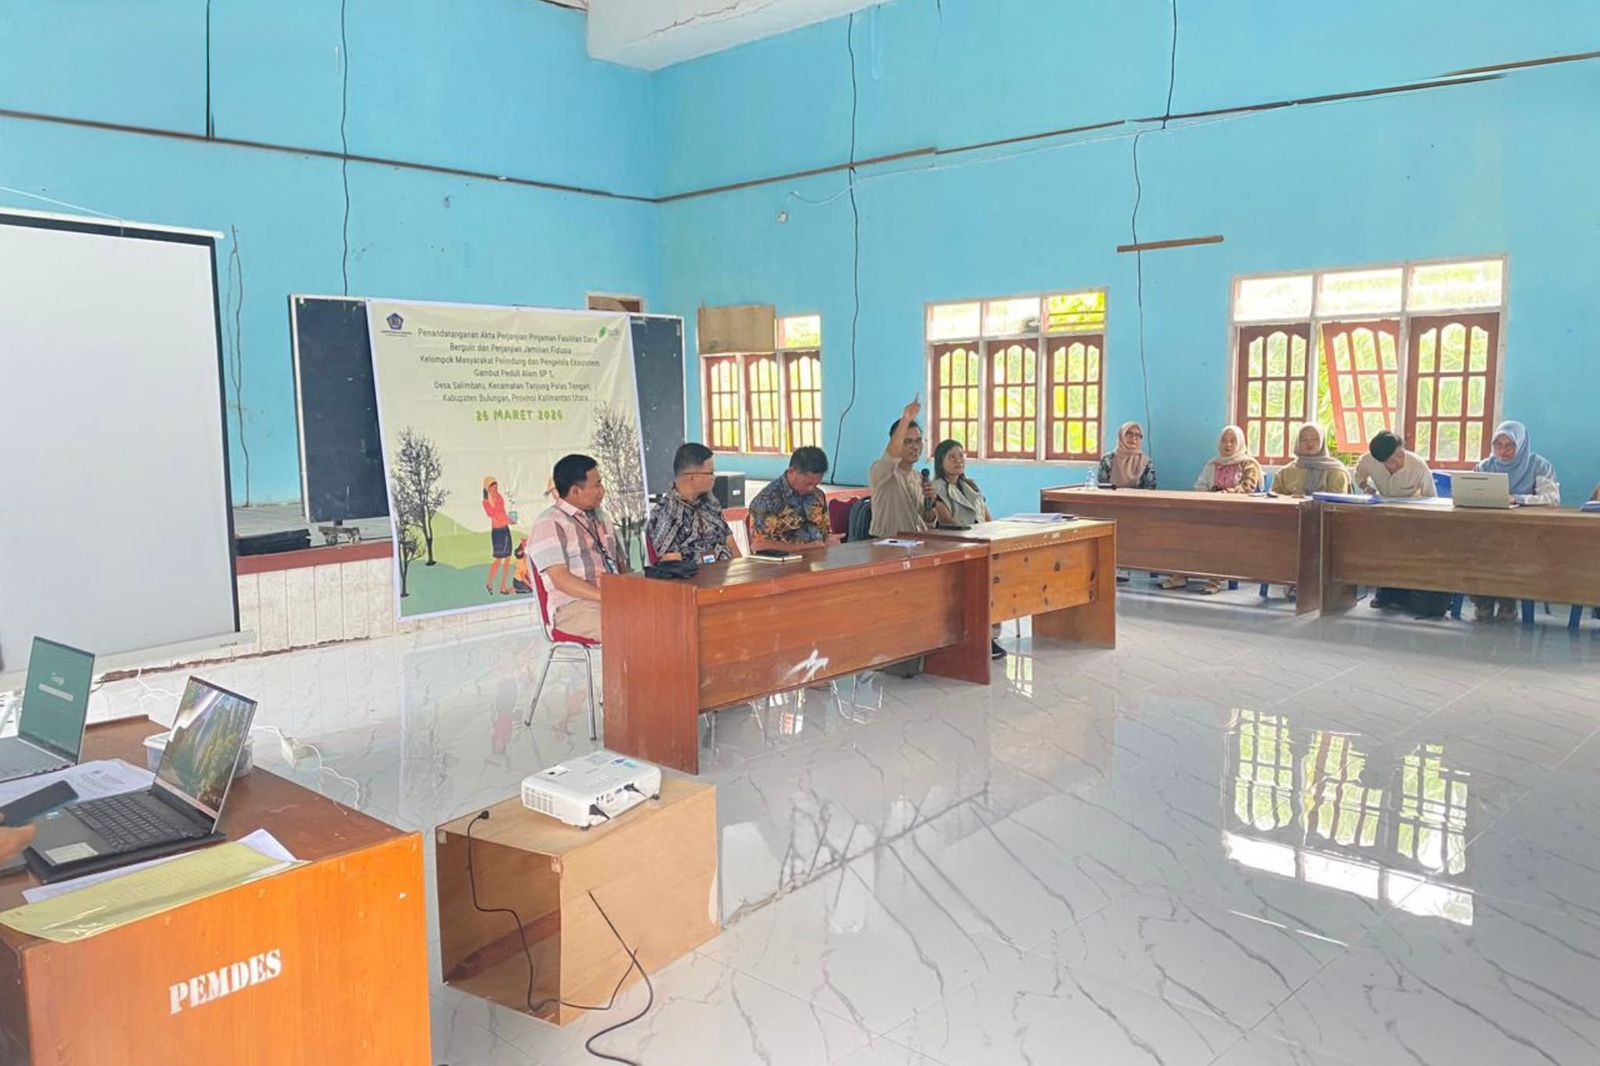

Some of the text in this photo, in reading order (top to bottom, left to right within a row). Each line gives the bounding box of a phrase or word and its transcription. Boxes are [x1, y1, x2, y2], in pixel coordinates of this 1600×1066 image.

[480, 330, 496, 339] Akta
[478, 344, 490, 352] dan
[420, 355, 454, 365] Kelompok
[455, 355, 494, 366] Masyarakat
[474, 368, 500, 377] Gambut
[500, 369, 520, 377] Peduli
[433, 381, 451, 389] Desa
[442, 393, 478, 403] Kabupaten
[494, 408, 532, 421] MARET
[169, 948, 282, 1016] PEMDES
